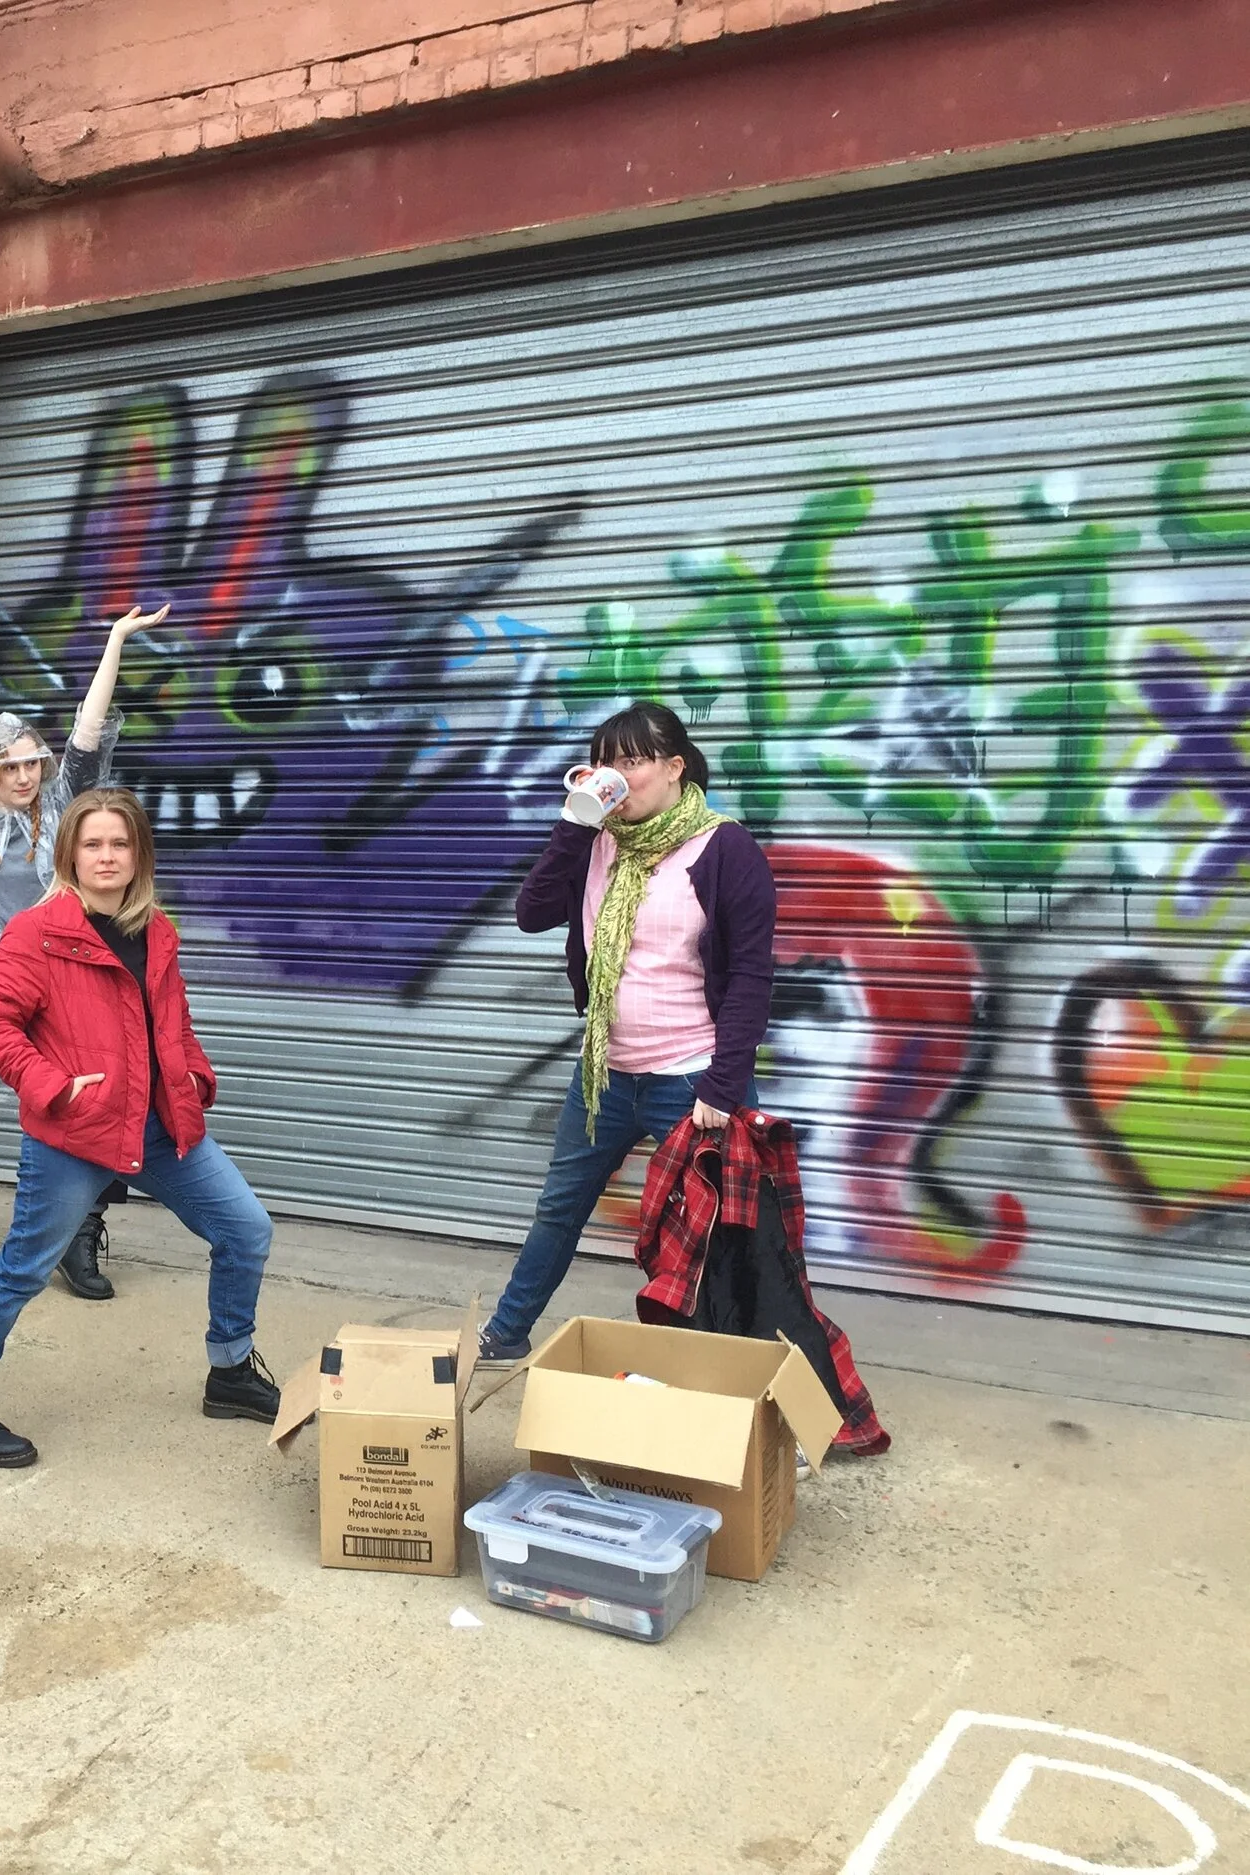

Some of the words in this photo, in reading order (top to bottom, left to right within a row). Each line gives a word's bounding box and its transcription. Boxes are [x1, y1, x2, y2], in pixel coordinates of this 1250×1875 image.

[366, 1446, 405, 1462] bondall
[339, 1474, 364, 1482] Belmont
[364, 1476, 390, 1484] Western
[391, 1478, 418, 1486] Australia
[368, 1468, 393, 1476] Belmont
[394, 1470, 417, 1478] Avenue
[360, 1484, 369, 1492] Ph
[382, 1486, 397, 1494] 6272
[352, 1498, 372, 1508] Pool
[374, 1500, 393, 1510] Acid
[394, 1502, 400, 1510] 4
[410, 1502, 421, 1512] 5L
[348, 1508, 404, 1521] Hydrochloric
[405, 1512, 425, 1522] Acid
[346, 1524, 370, 1534] Gross
[371, 1526, 401, 1536] Weight:
[402, 1528, 428, 1538] 23.2kg
